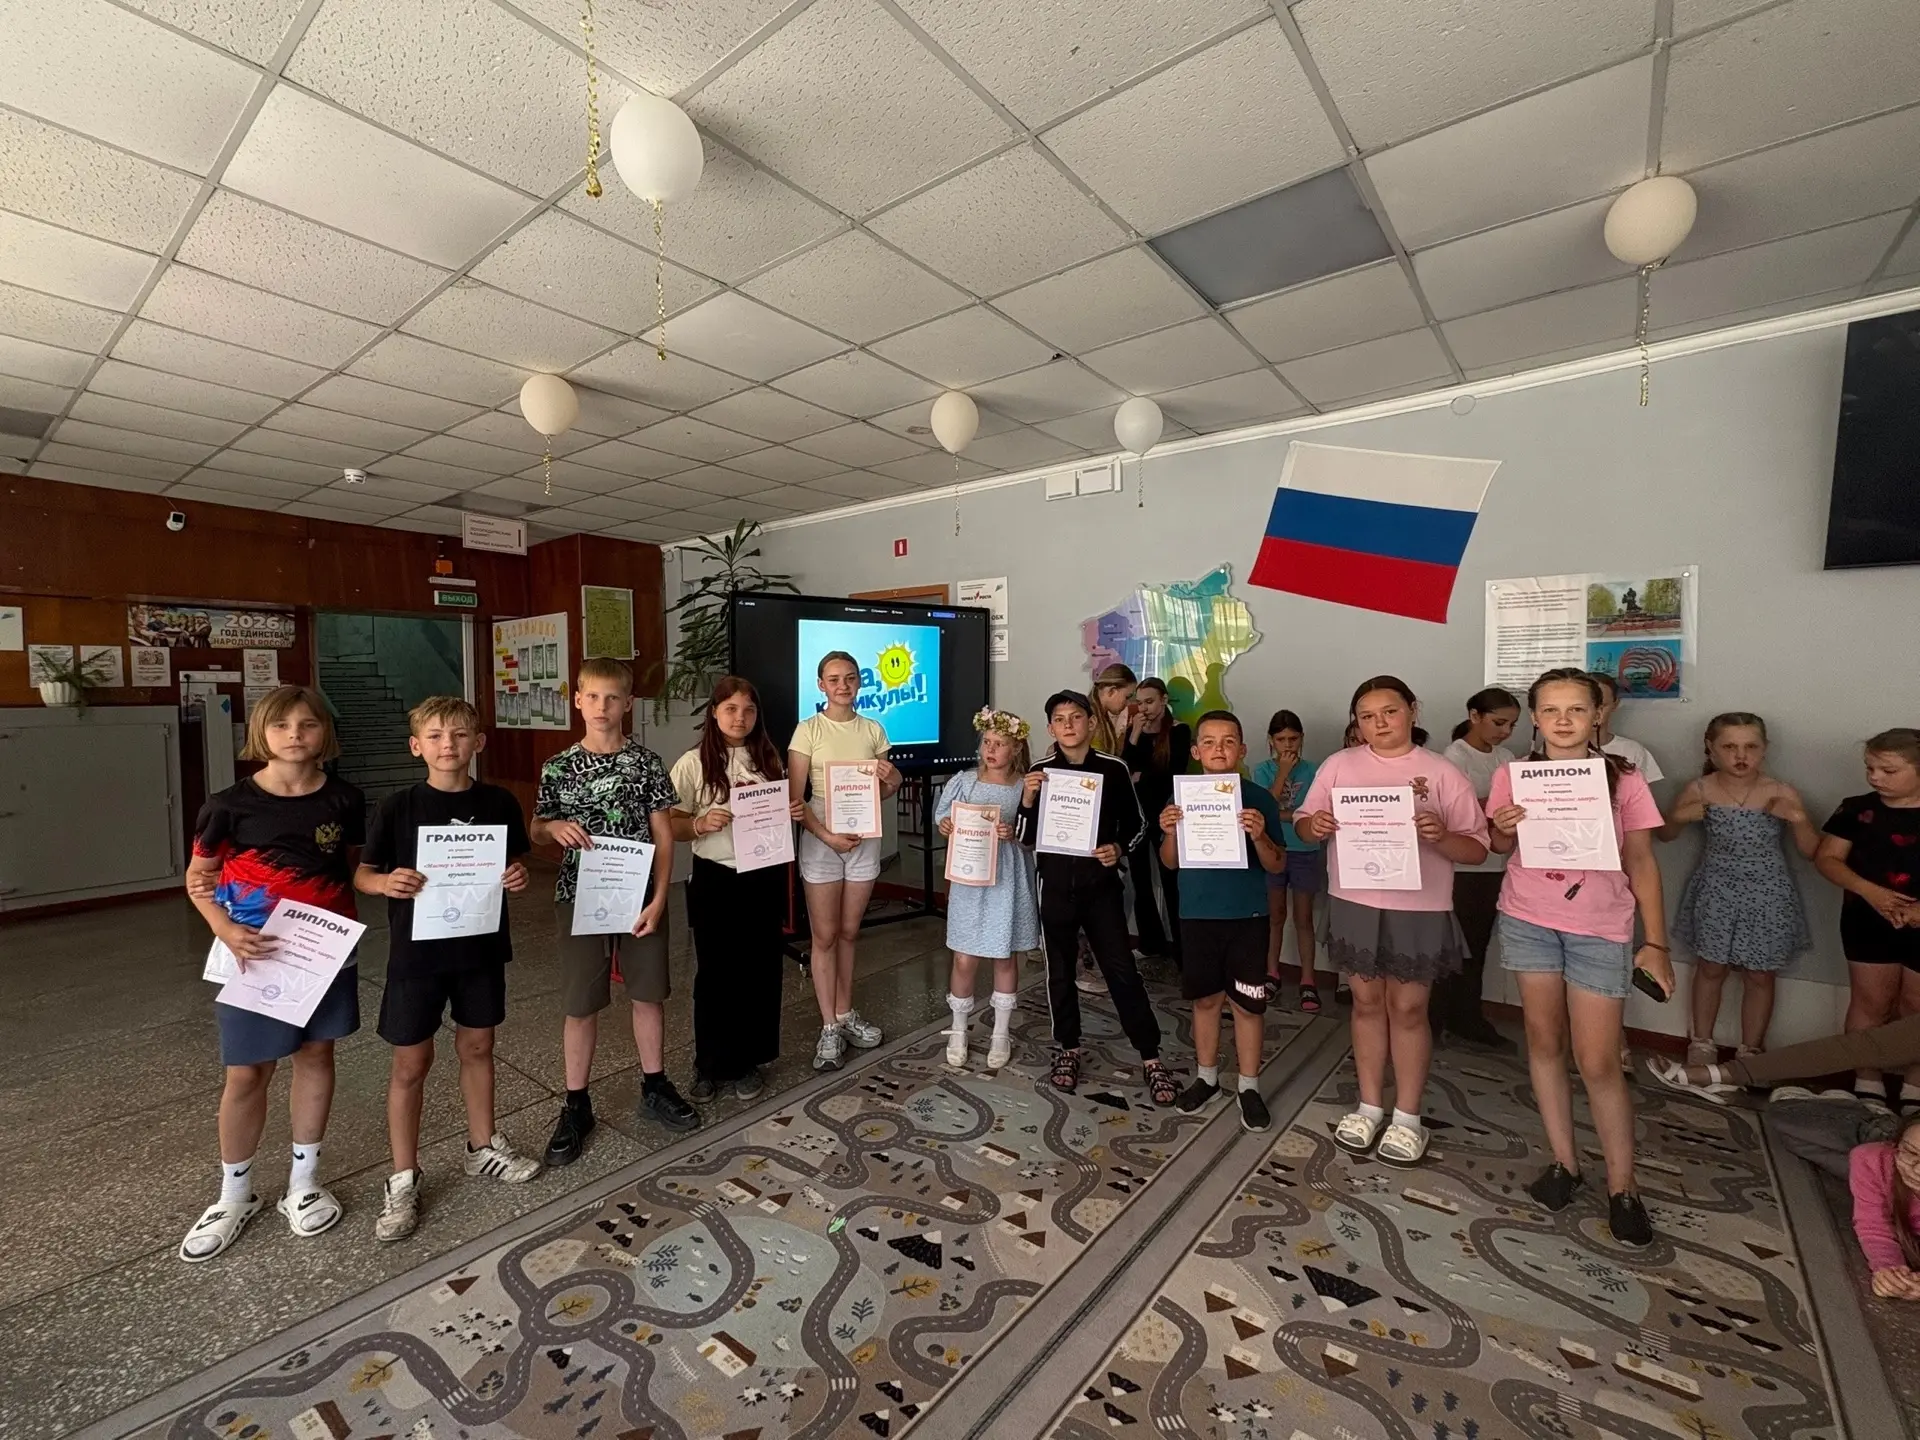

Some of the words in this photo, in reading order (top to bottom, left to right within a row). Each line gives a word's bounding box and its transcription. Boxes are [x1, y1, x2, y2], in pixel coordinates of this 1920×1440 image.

[441, 594, 474, 604] ВЫХОД
[225, 614, 280, 630] 2026
[220, 628, 238, 637] ГОД
[240, 629, 285, 639] ЕДИНСТВА
[213, 638, 256, 646] НАРОДОВ
[257, 639, 292, 648] РОССИИ
[815, 673, 925, 713] кикулы!
[1521, 767, 1591, 779] ДИПЛОМ
[738, 786, 782, 800] ДИПЛОМ
[834, 784, 871, 792] ДИПЛОМ
[1050, 794, 1091, 805] ДИПЛОМ
[1340, 795, 1400, 804] ДИПЛОМ
[1186, 804, 1231, 813] ДИПЛОМ
[957, 827, 991, 837] ДИПЛОМ
[426, 833, 496, 843] ГРАМОТА
[593, 843, 644, 856] РАМОТА
[283, 909, 350, 936] ДИПЛОМ
